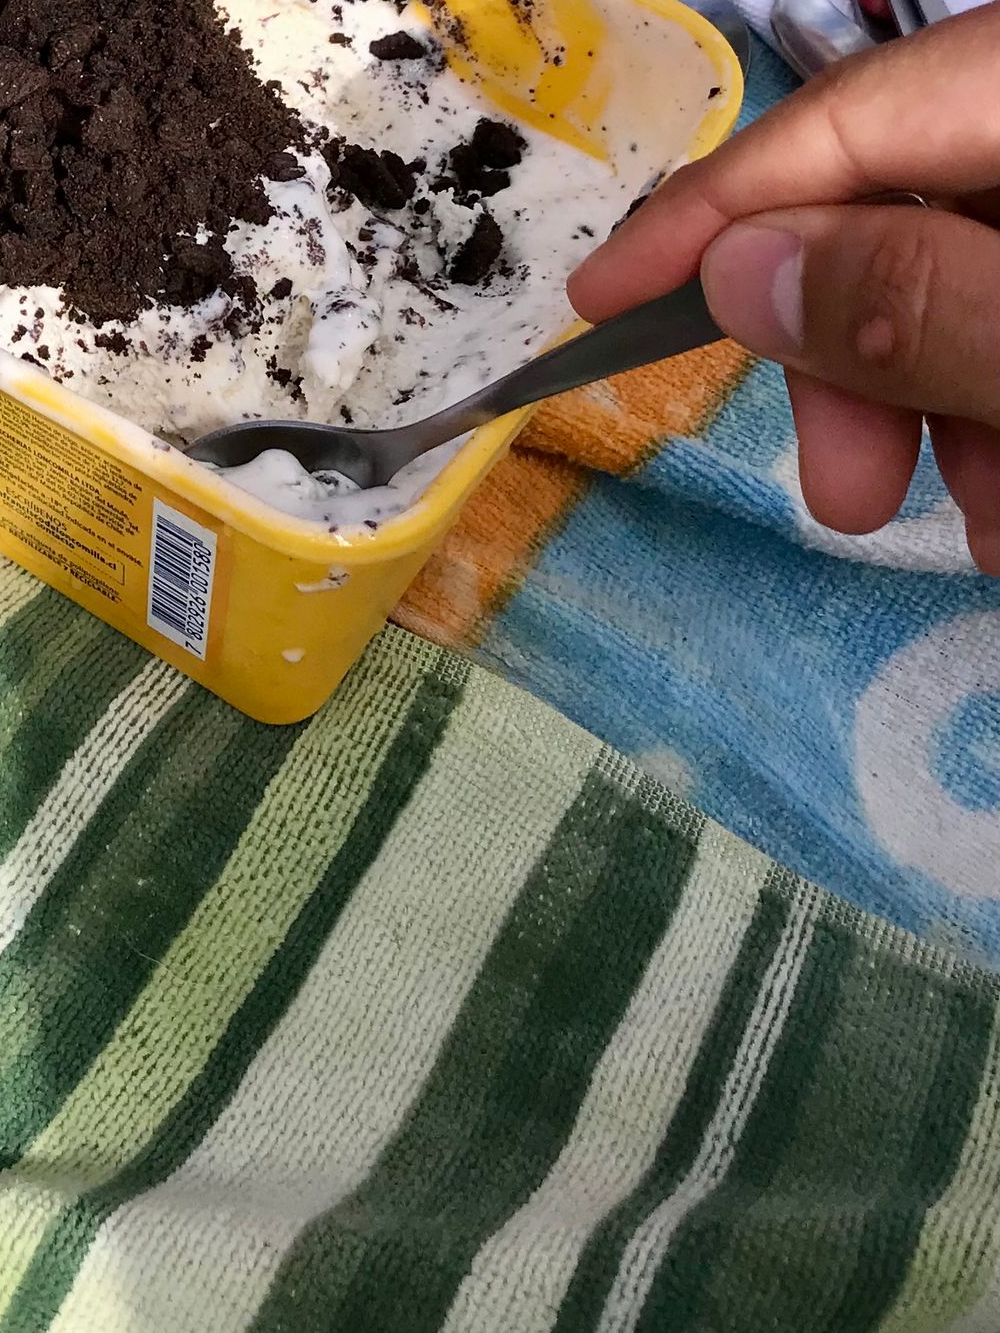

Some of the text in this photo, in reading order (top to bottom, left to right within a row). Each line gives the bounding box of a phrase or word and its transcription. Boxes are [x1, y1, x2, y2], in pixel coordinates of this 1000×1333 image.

[32, 448, 80, 483] LONCOMILLA
[4, 484, 67, 532] ESCRÍBENOS
[8, 527, 61, 567] REUTILIZABLE
[34, 519, 75, 550] contacto
[185, 542, 212, 655] 7 802926 001580
